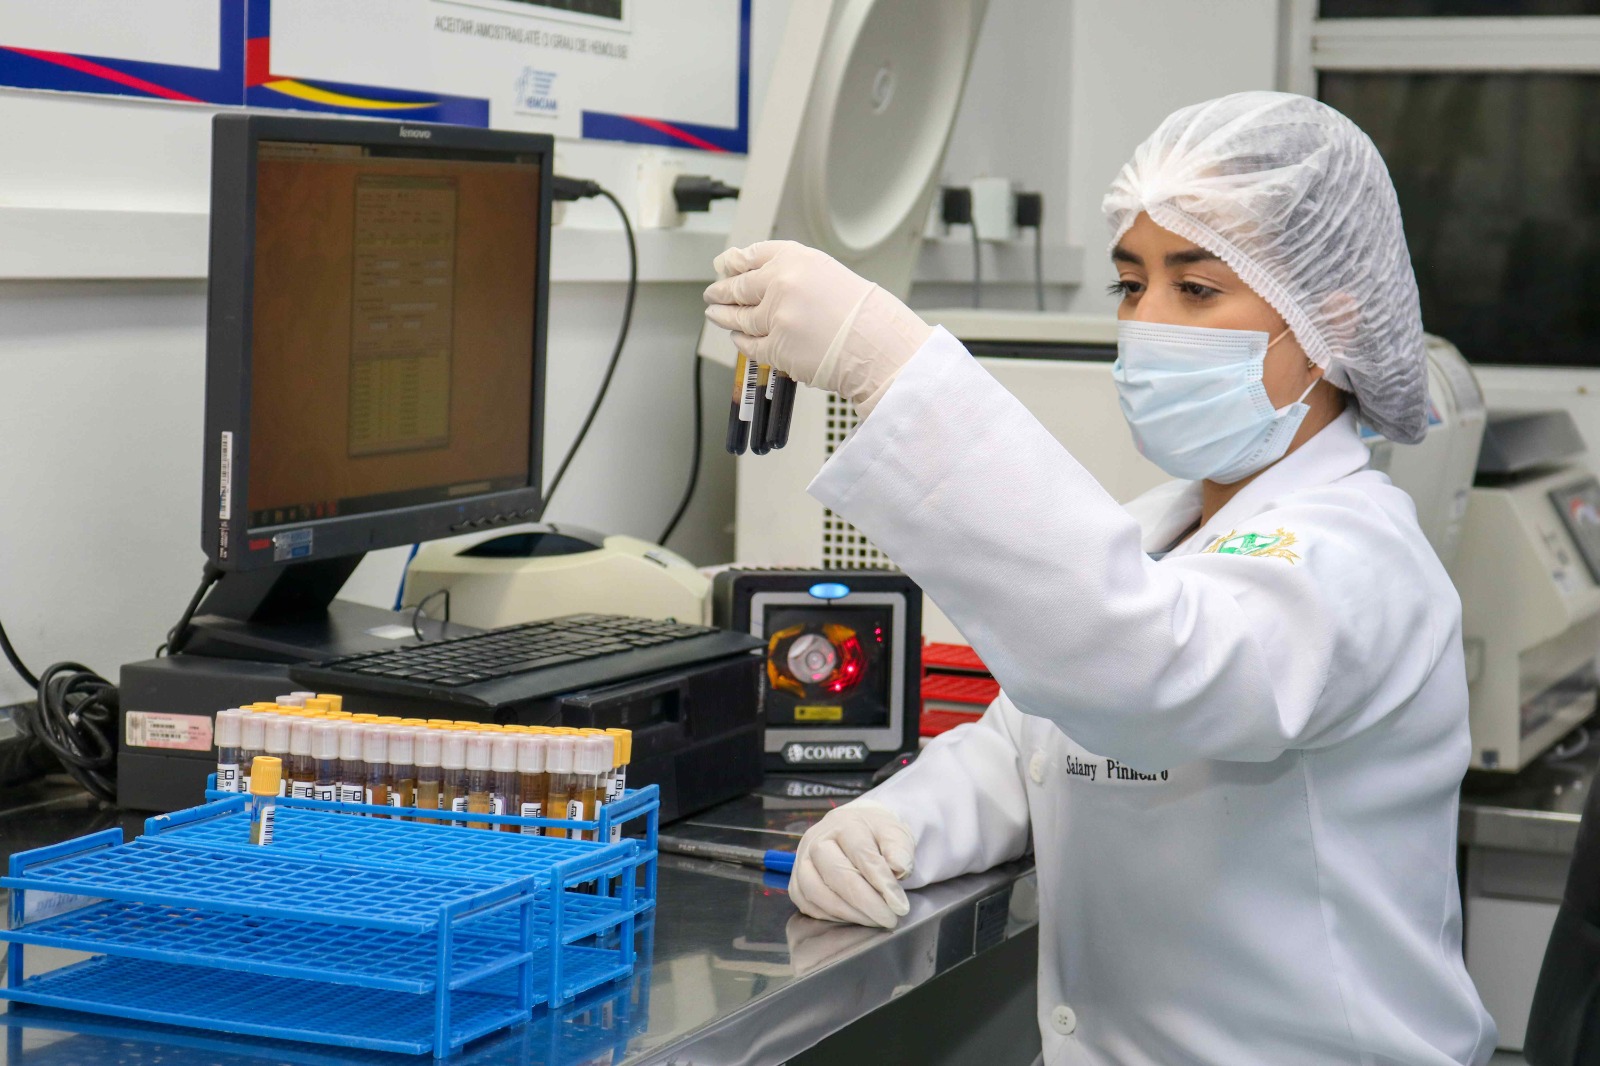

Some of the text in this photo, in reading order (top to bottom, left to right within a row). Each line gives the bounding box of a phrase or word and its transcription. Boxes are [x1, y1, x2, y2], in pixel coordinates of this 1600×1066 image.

[434, 15, 473, 36] ACEITAR
[474, 22, 524, 44] AMOSTRAS
[804, 746, 863, 760] COMPEX
